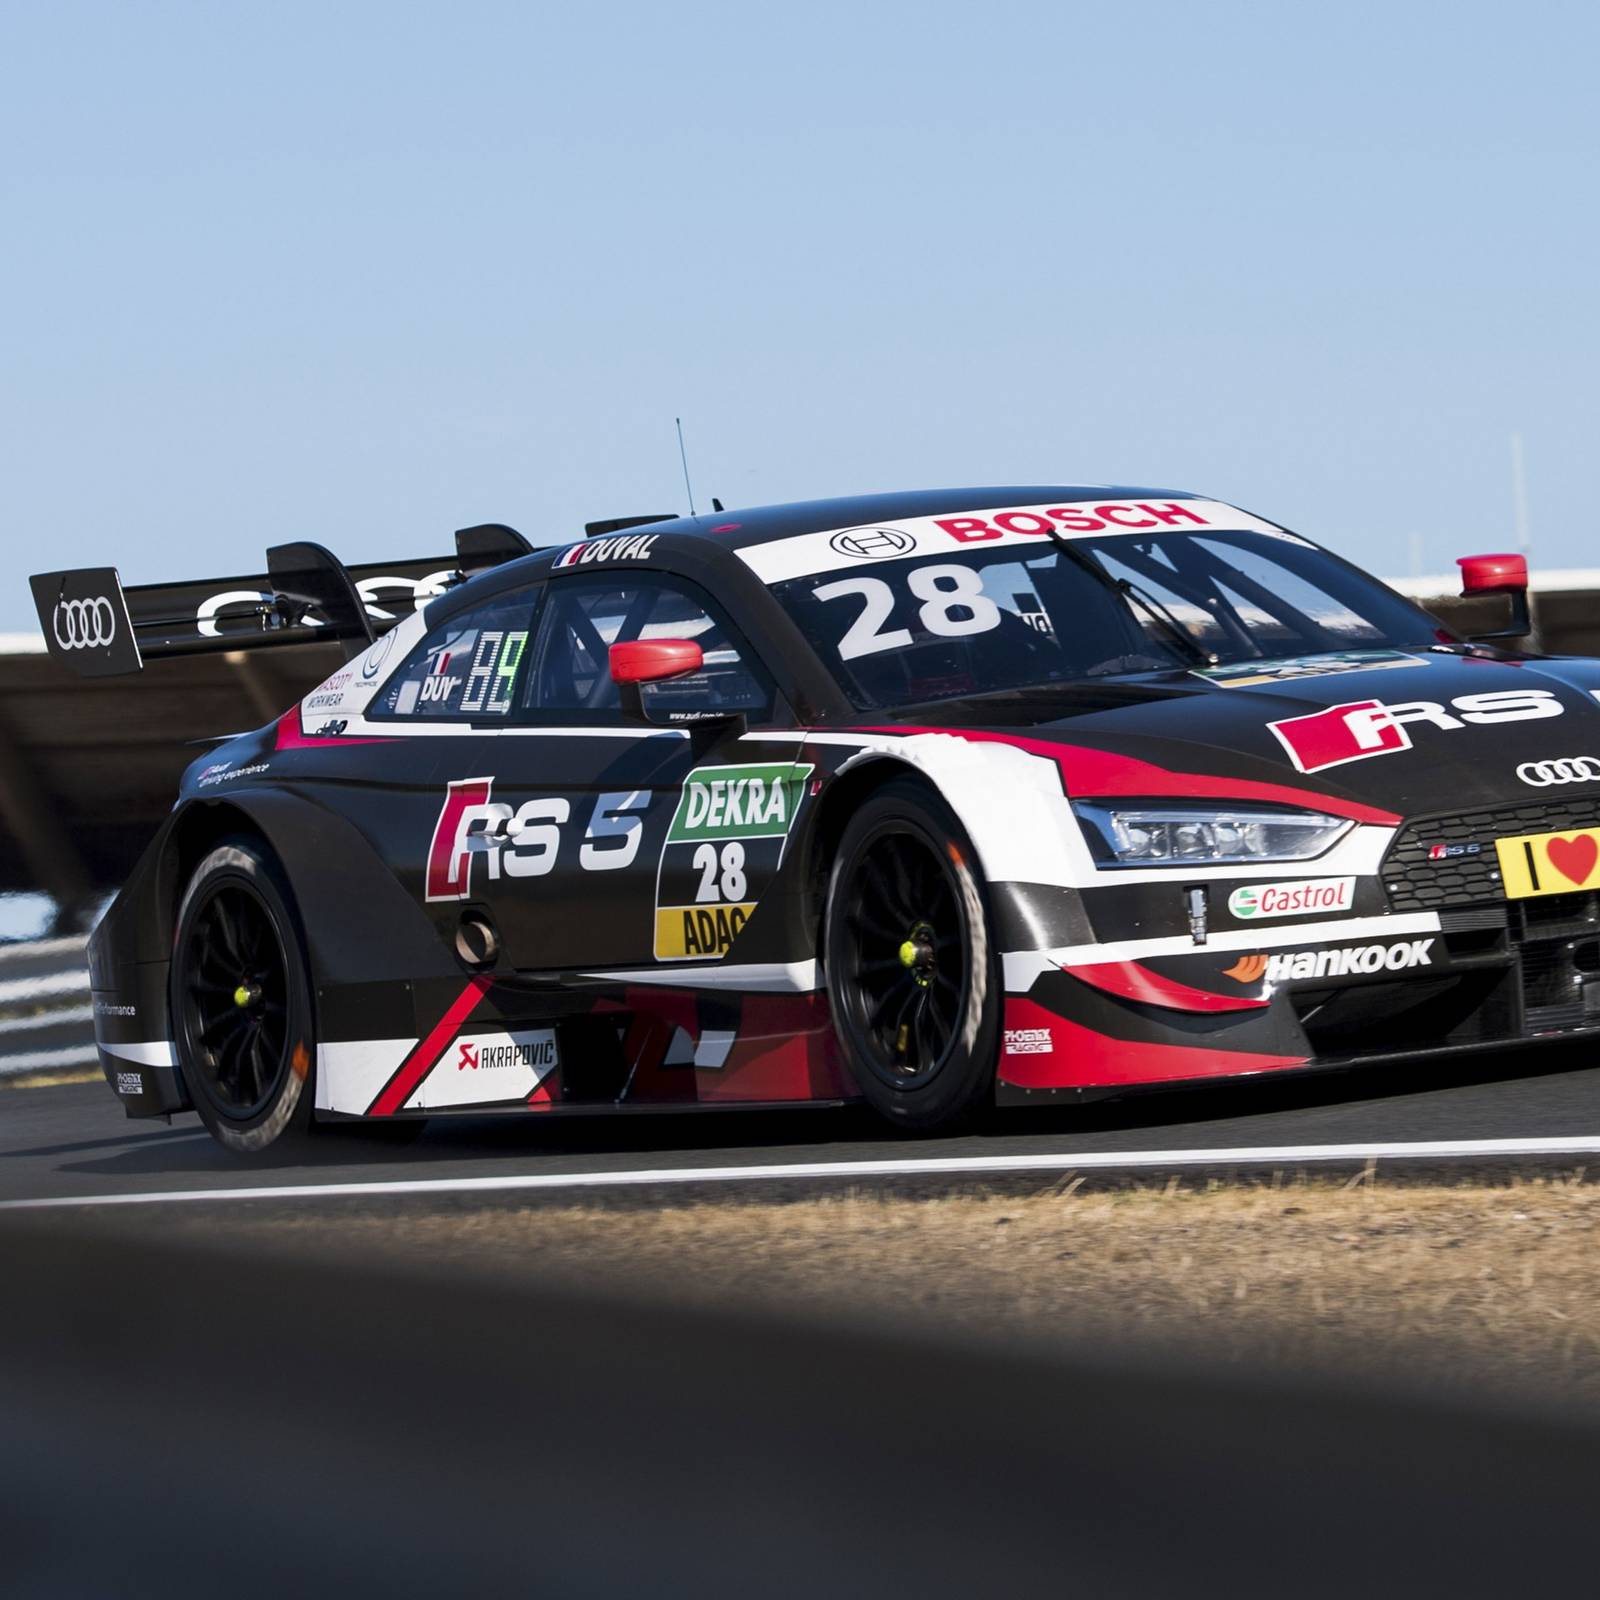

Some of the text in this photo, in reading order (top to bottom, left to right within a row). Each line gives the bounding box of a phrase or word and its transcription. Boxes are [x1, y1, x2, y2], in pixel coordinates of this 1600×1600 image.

[579, 534, 660, 564] DUVAL
[933, 503, 1211, 544] BOSCH
[811, 563, 1001, 661] 28
[1343, 689, 1564, 750] RS
[685, 776, 785, 829] DEKRA
[447, 789, 653, 883] RS 5
[692, 841, 748, 903] 28
[1261, 883, 1345, 911] Castrol
